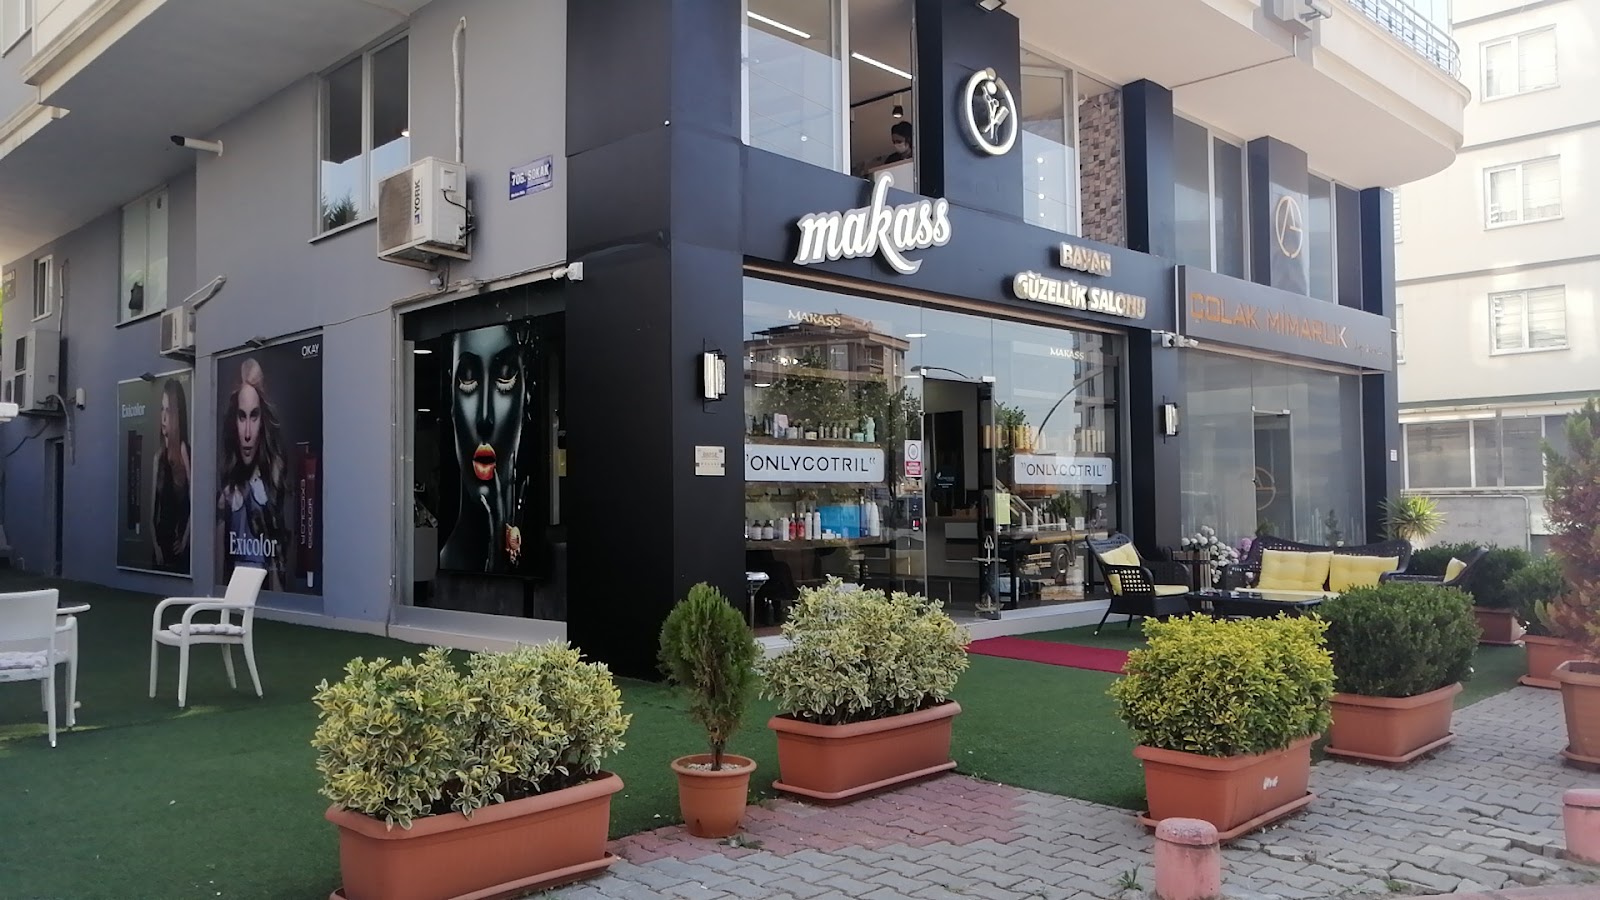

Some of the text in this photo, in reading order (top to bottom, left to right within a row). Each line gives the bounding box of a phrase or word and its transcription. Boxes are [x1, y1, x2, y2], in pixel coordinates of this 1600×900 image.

[527, 163, 550, 181] SOKAK
[794, 172, 951, 274] makass
[1060, 242, 1111, 276] BAYAN
[1088, 287, 1146, 319] SALONU
[787, 309, 841, 327] MAKASS
[301, 343, 320, 356] OKAY
[1050, 347, 1085, 360] MAKASS
[121, 403, 146, 418] Exicolor
[229, 531, 277, 557] Exicolor
